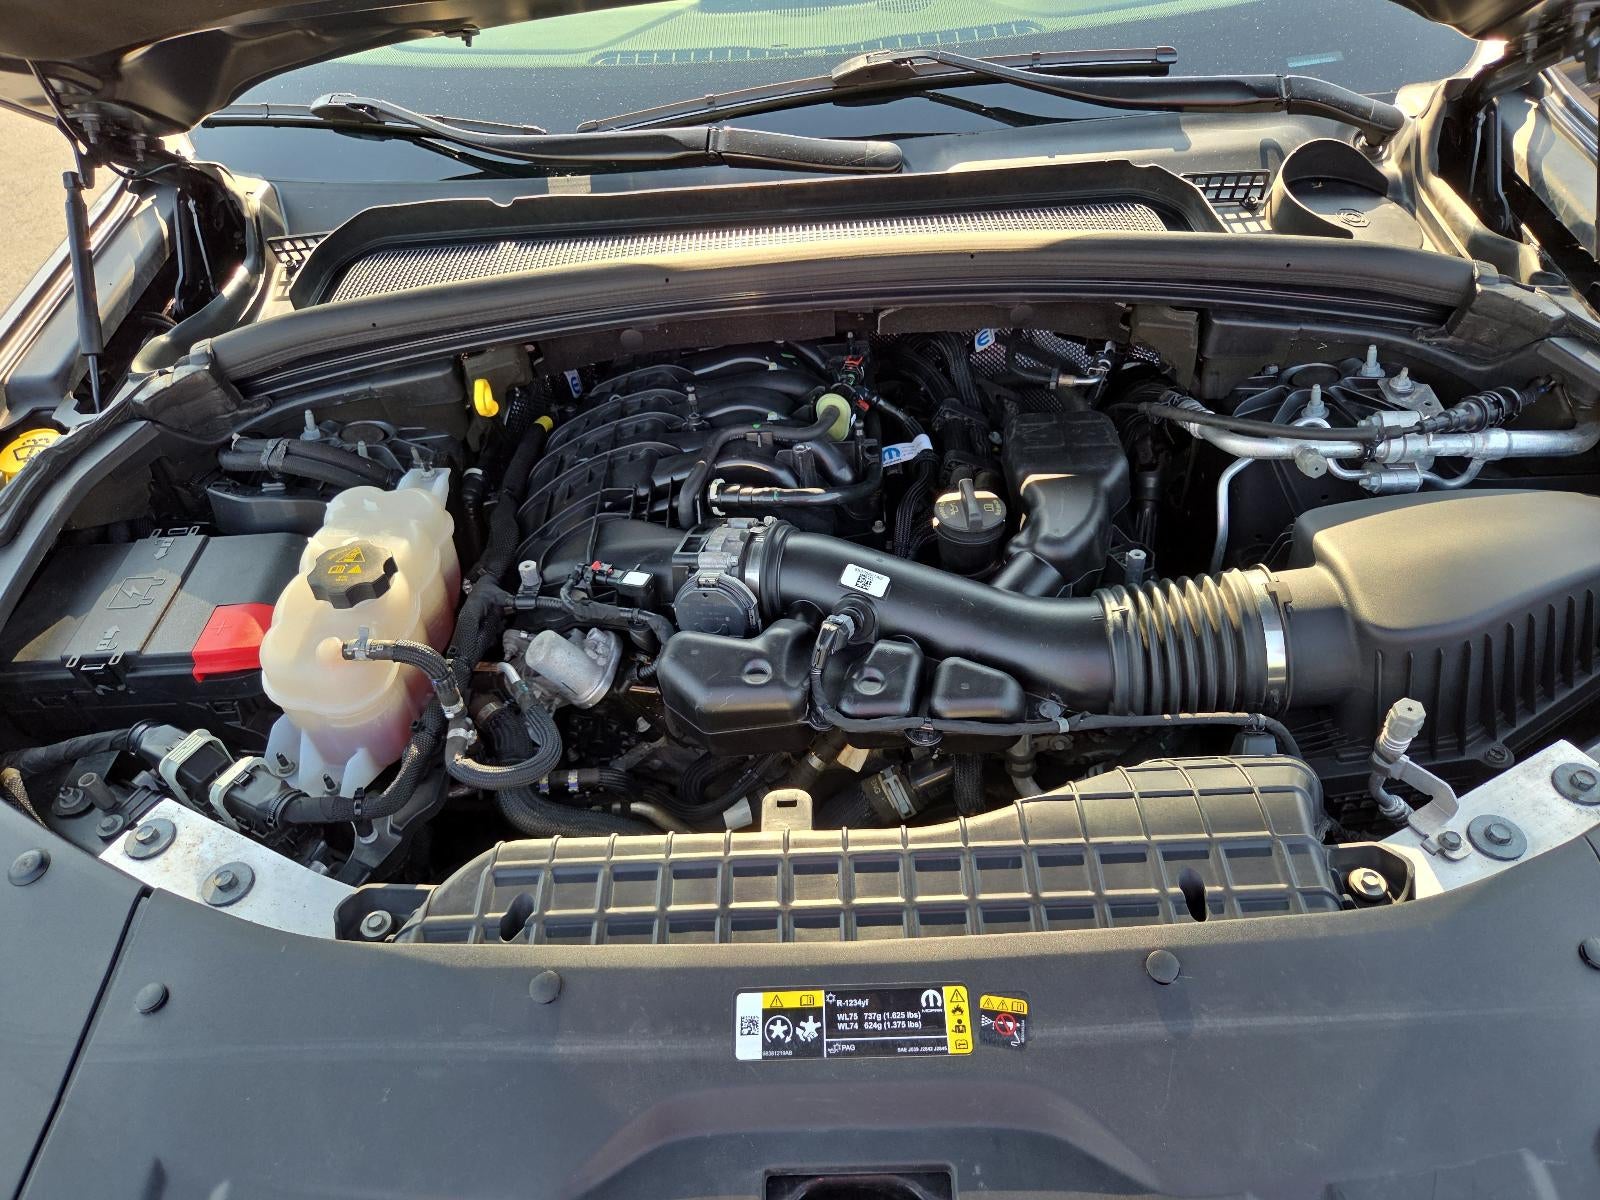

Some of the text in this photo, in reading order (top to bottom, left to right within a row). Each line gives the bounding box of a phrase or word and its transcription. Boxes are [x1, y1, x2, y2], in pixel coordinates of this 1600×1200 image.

[836, 998, 869, 1008] R-1234yf
[837, 1011, 921, 1021] WL75 737g (1.625 lbs)
[837, 1020, 922, 1031] WL74 624g (1.375 lbs)
